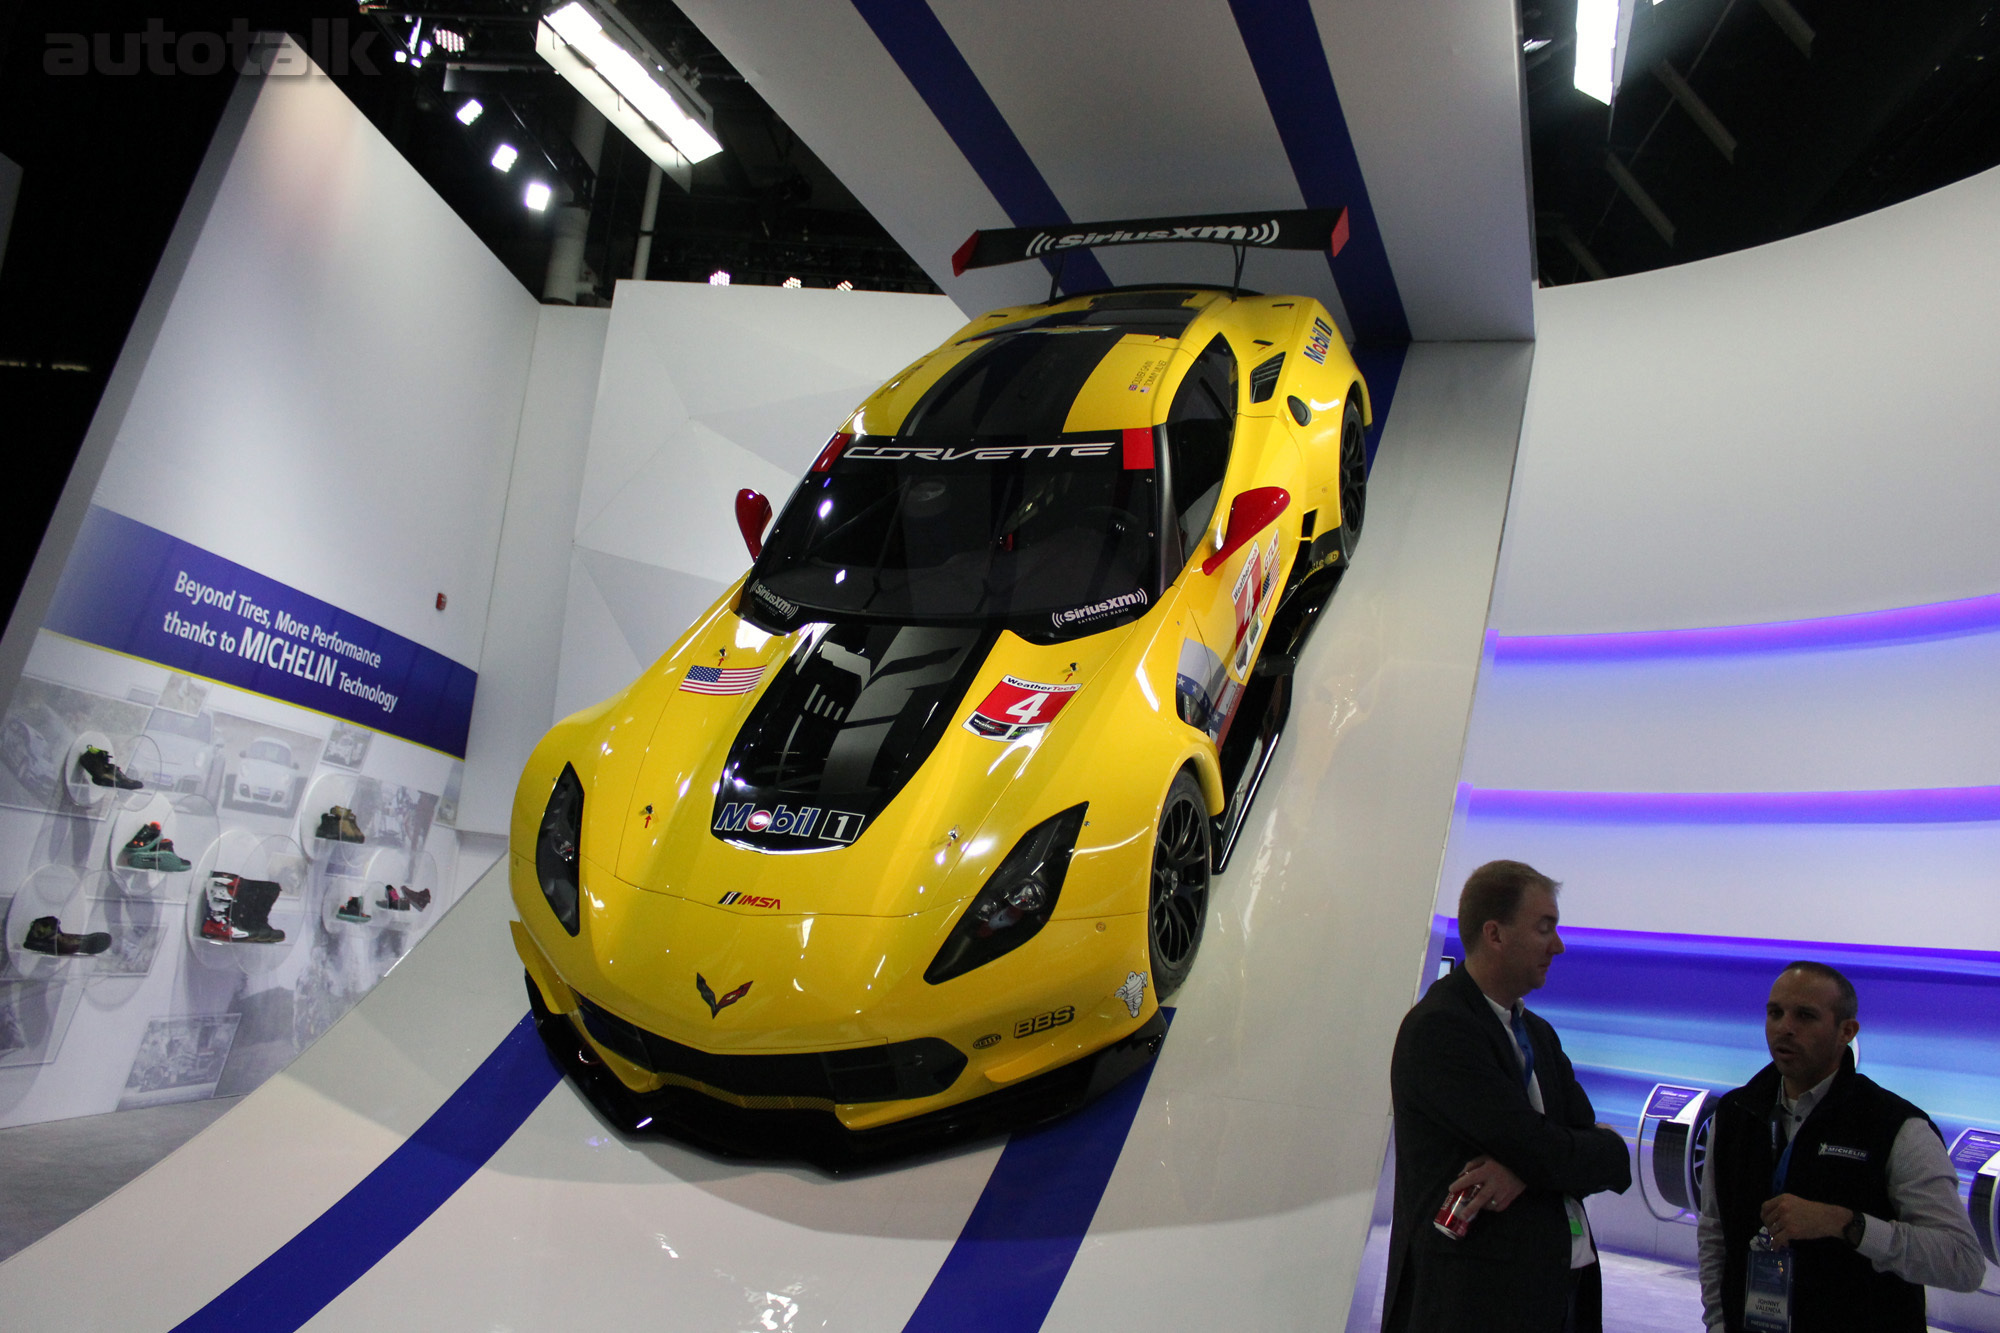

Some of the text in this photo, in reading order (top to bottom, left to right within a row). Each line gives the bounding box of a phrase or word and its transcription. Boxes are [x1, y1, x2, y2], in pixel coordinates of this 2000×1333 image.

[1303, 326, 1331, 365] Mobil
[843, 442, 1116, 461] CORVETTE
[1263, 532, 1279, 571] GTLM
[1232, 548, 1258, 601] WeatherTech
[1243, 573, 1255, 626] 4
[174, 570, 382, 669] Beyond Tires, More Performance
[1077, 607, 1129, 625] SATELLITE RADIO
[163, 610, 399, 714] thanks to MICHELIN Technology
[1007, 677, 1077, 692] WeatherTech
[1005, 692, 1050, 723] 4
[713, 802, 850, 839] Mobil 1
[737, 894, 781, 910] IMSA
[1014, 1005, 1075, 1039] BBS
[1828, 1147, 1867, 1158] MICHELIN
[1754, 1303, 1782, 1314] VALENCIA
[1757, 1298, 1780, 1308] JOHNNY
